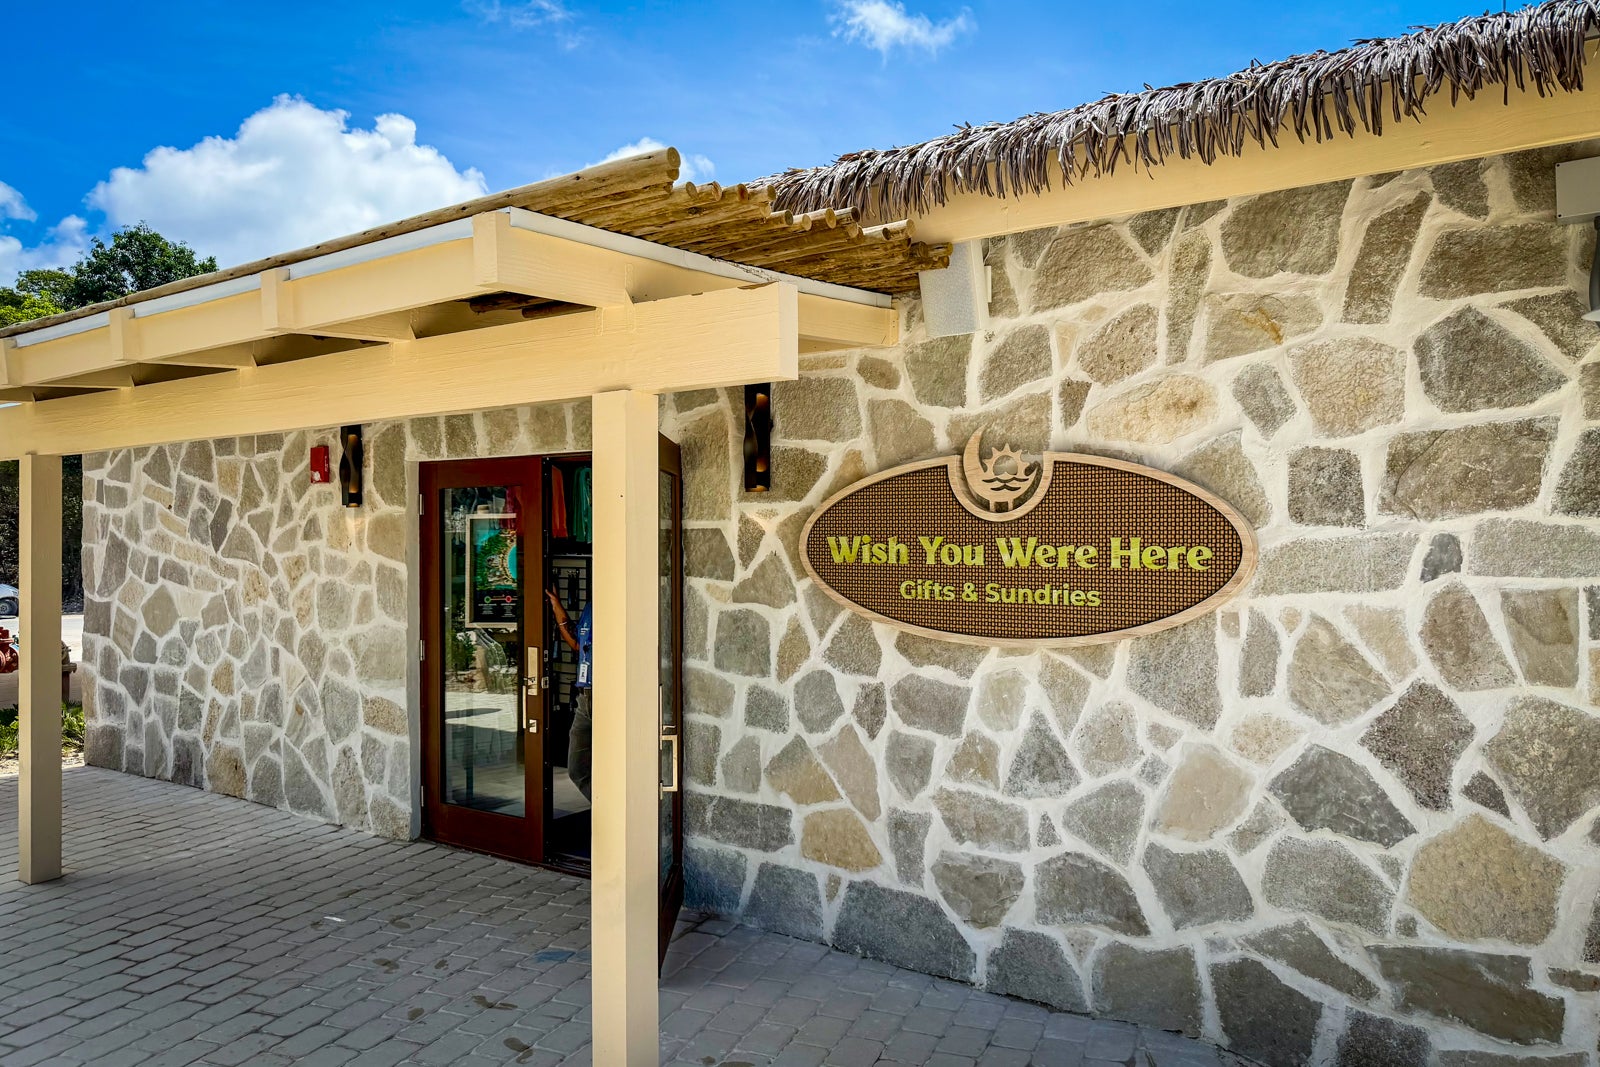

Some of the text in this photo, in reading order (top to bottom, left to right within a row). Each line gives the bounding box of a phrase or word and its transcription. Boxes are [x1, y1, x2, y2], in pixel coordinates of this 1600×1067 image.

[827, 535, 1213, 571] Wish You Were Here
[900, 580, 1101, 606] Gifts & Sundries
